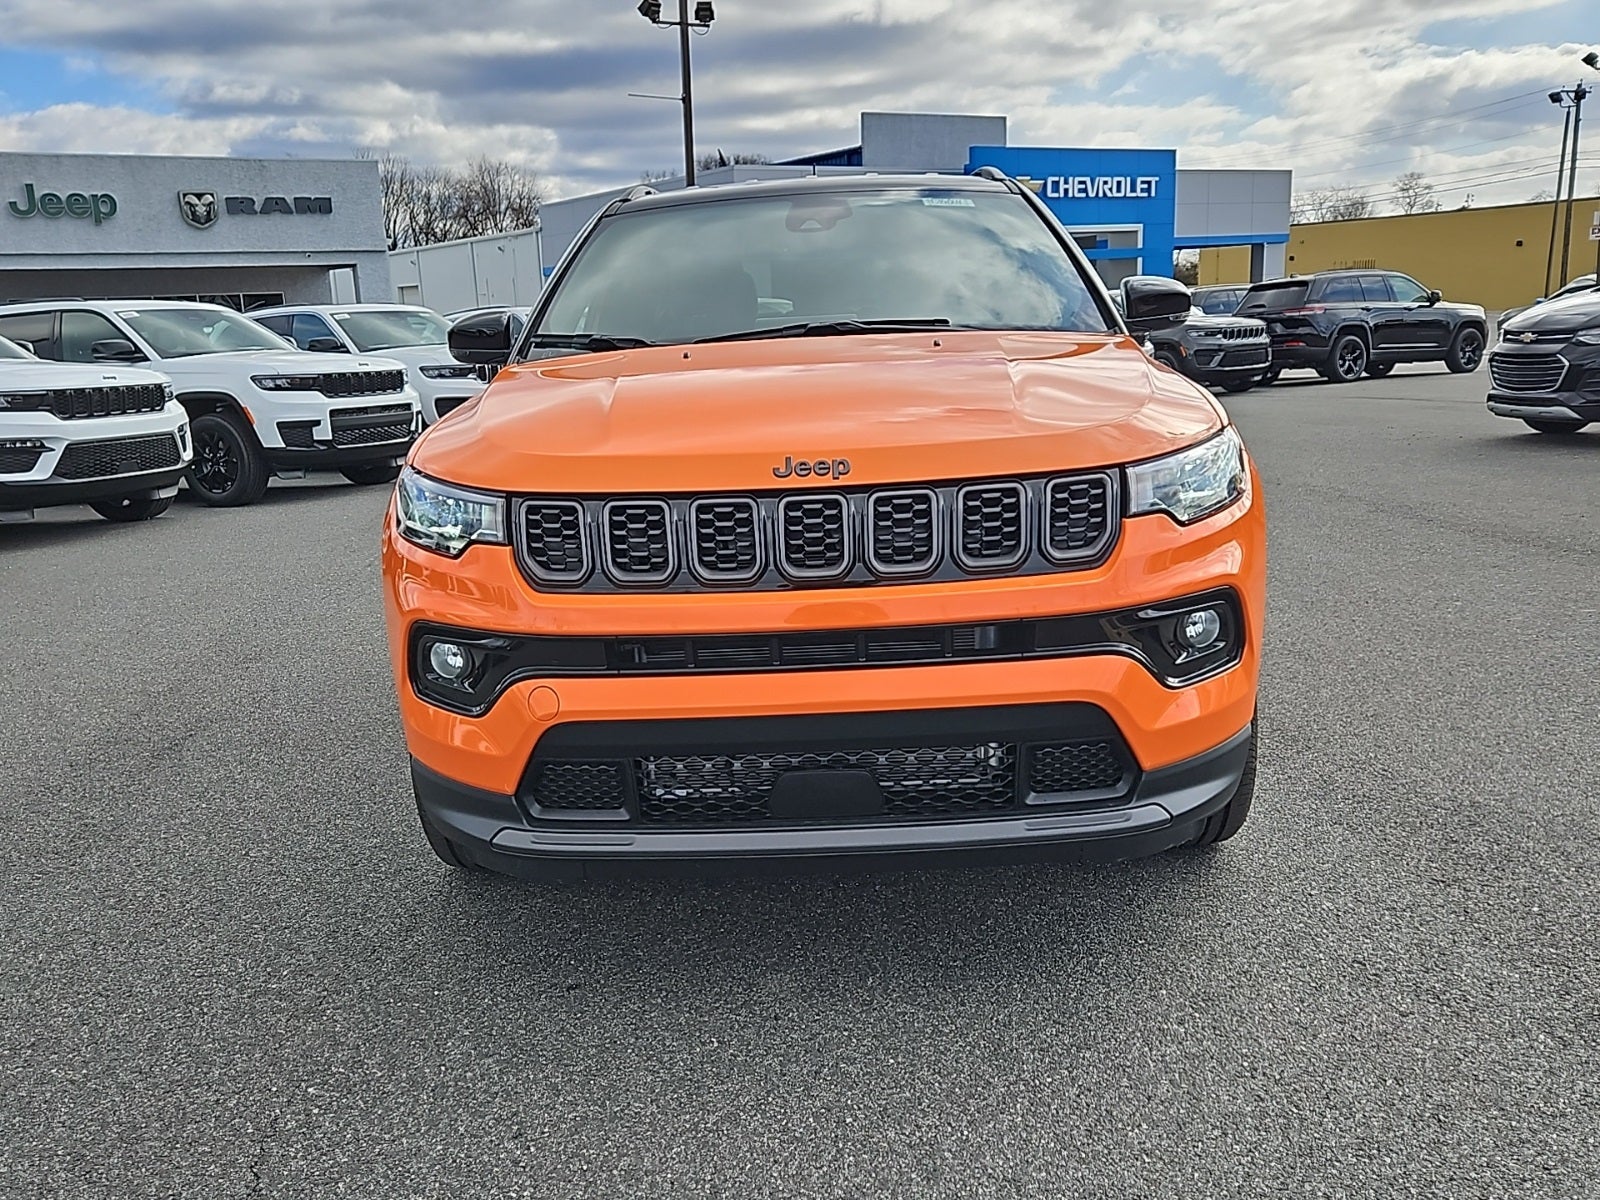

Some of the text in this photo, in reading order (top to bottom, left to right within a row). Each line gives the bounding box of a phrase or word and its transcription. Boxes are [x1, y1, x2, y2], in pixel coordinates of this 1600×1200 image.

[1046, 176, 1160, 198] CHEVROLET
[8, 183, 118, 226] Jeep
[224, 196, 333, 215] RAM
[772, 456, 850, 480] Jeep
